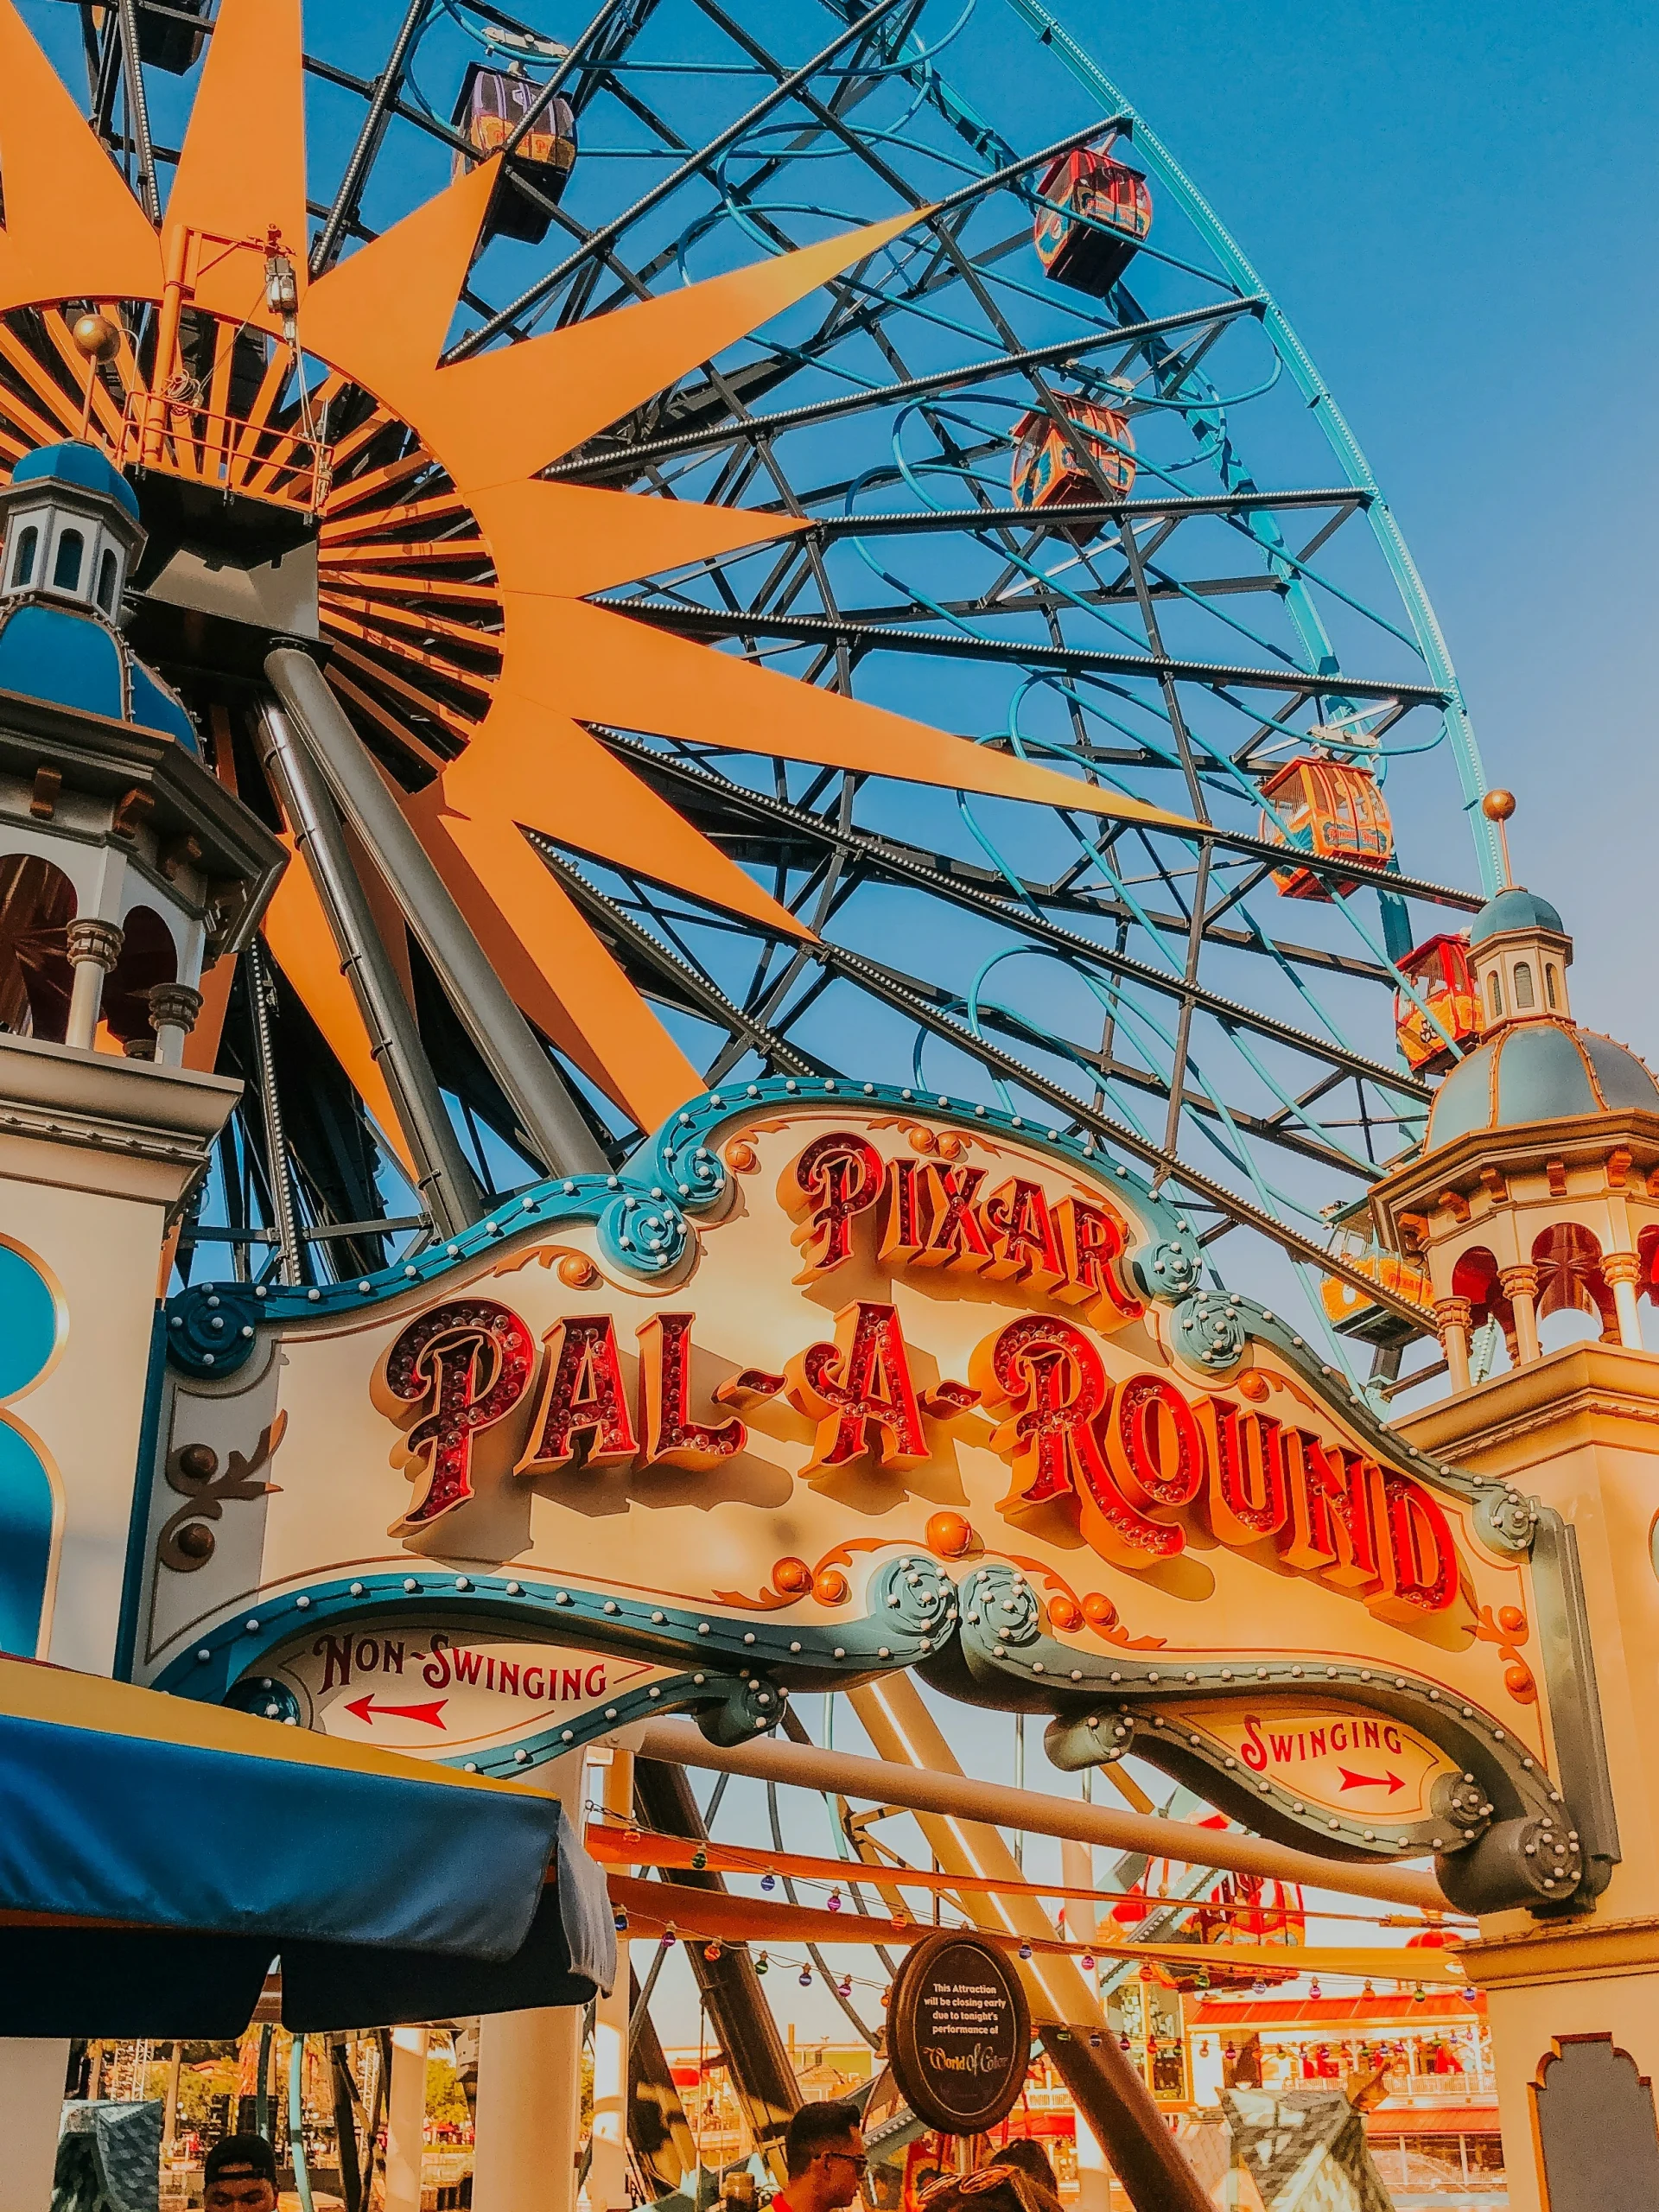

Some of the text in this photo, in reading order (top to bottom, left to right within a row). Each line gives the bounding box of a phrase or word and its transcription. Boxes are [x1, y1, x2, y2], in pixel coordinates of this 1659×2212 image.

[782, 1130, 1147, 1331] PIXAR
[312, 1633, 607, 1701] NON-SWINGING
[1241, 1714, 1402, 1771] SWINGING
[932, 1983, 997, 1994] This Attraction
[924, 1996, 1007, 2010] will be closing early
[932, 2010, 999, 2023] due to tonight's
[932, 2024, 999, 2035] performance of
[920, 2046, 966, 2071] World
